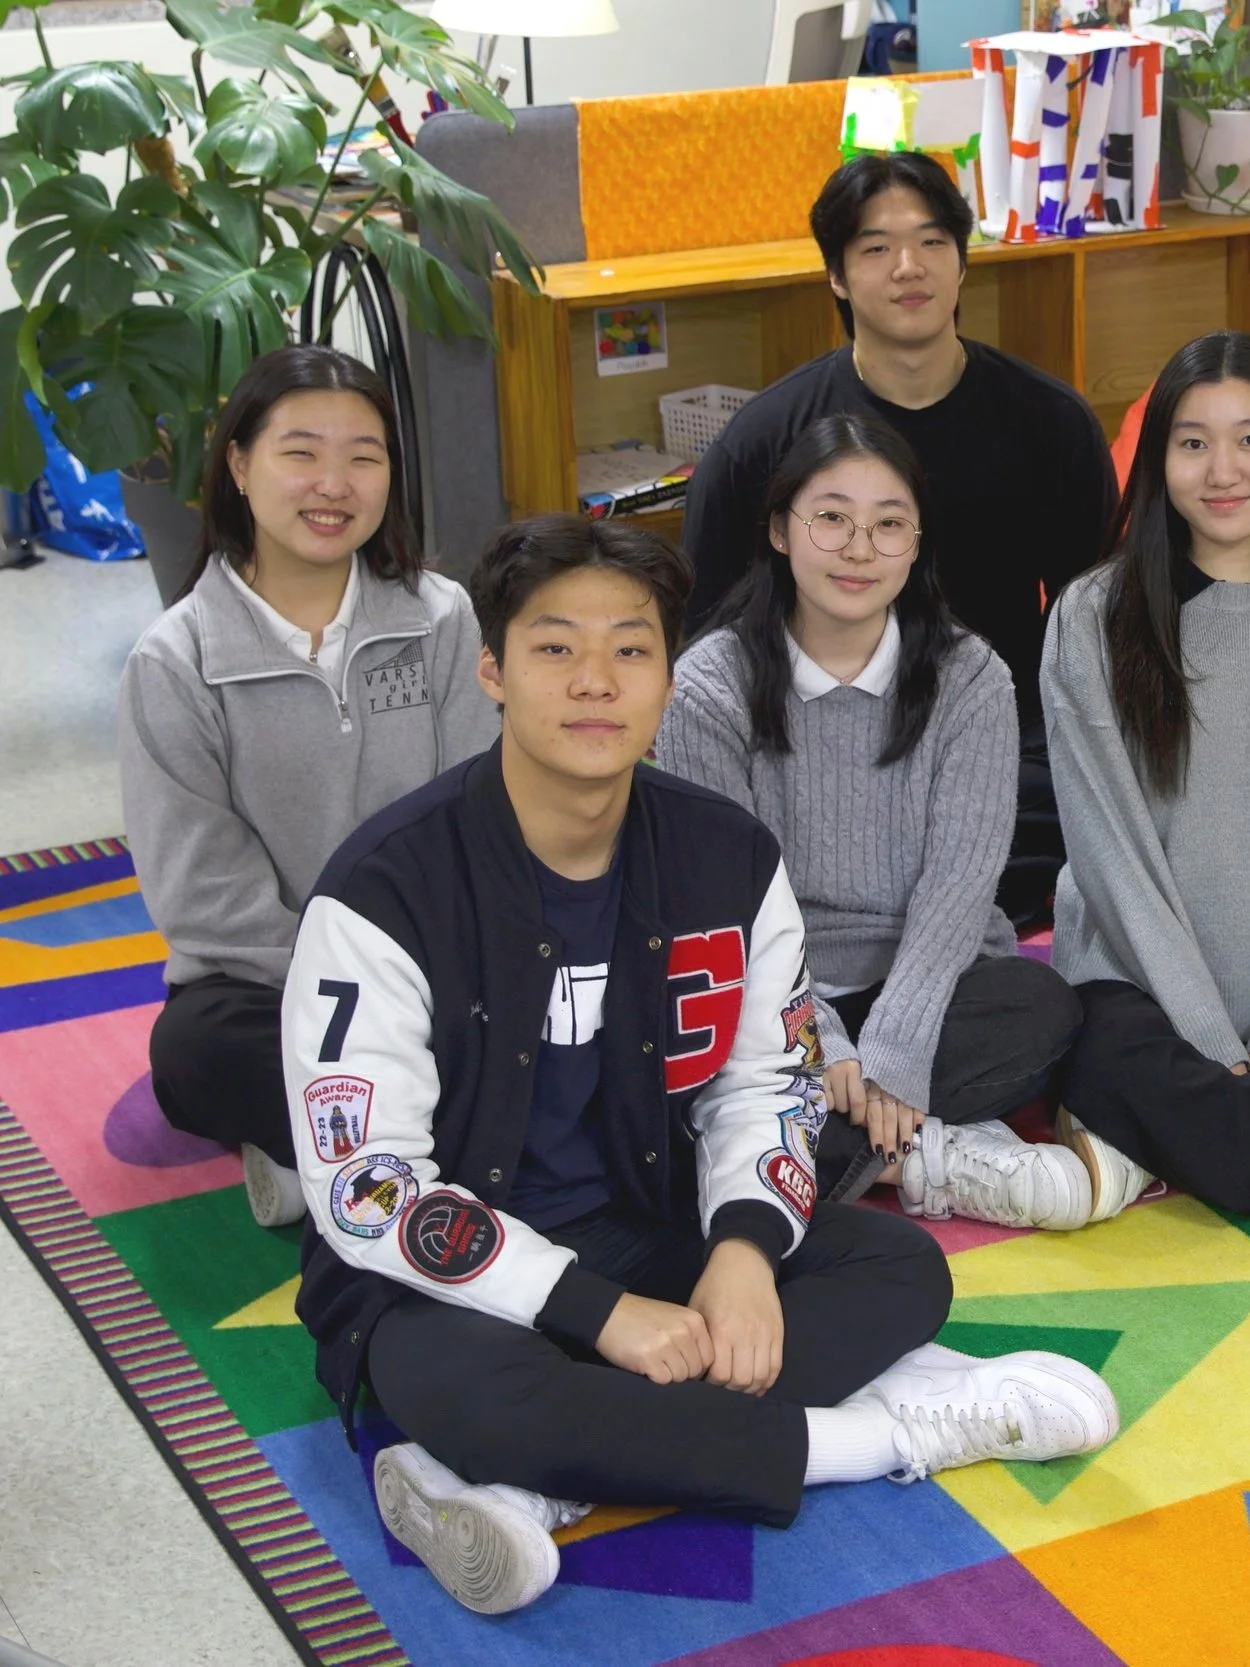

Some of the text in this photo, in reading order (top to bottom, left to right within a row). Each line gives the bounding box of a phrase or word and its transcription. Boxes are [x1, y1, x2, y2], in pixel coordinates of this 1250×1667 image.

[317, 978, 360, 1063] 7
[308, 1081, 367, 1102] Guardian
[319, 1094, 354, 1107] Award
[317, 1117, 328, 1148] 22-23
[777, 1159, 813, 1208] KBC
